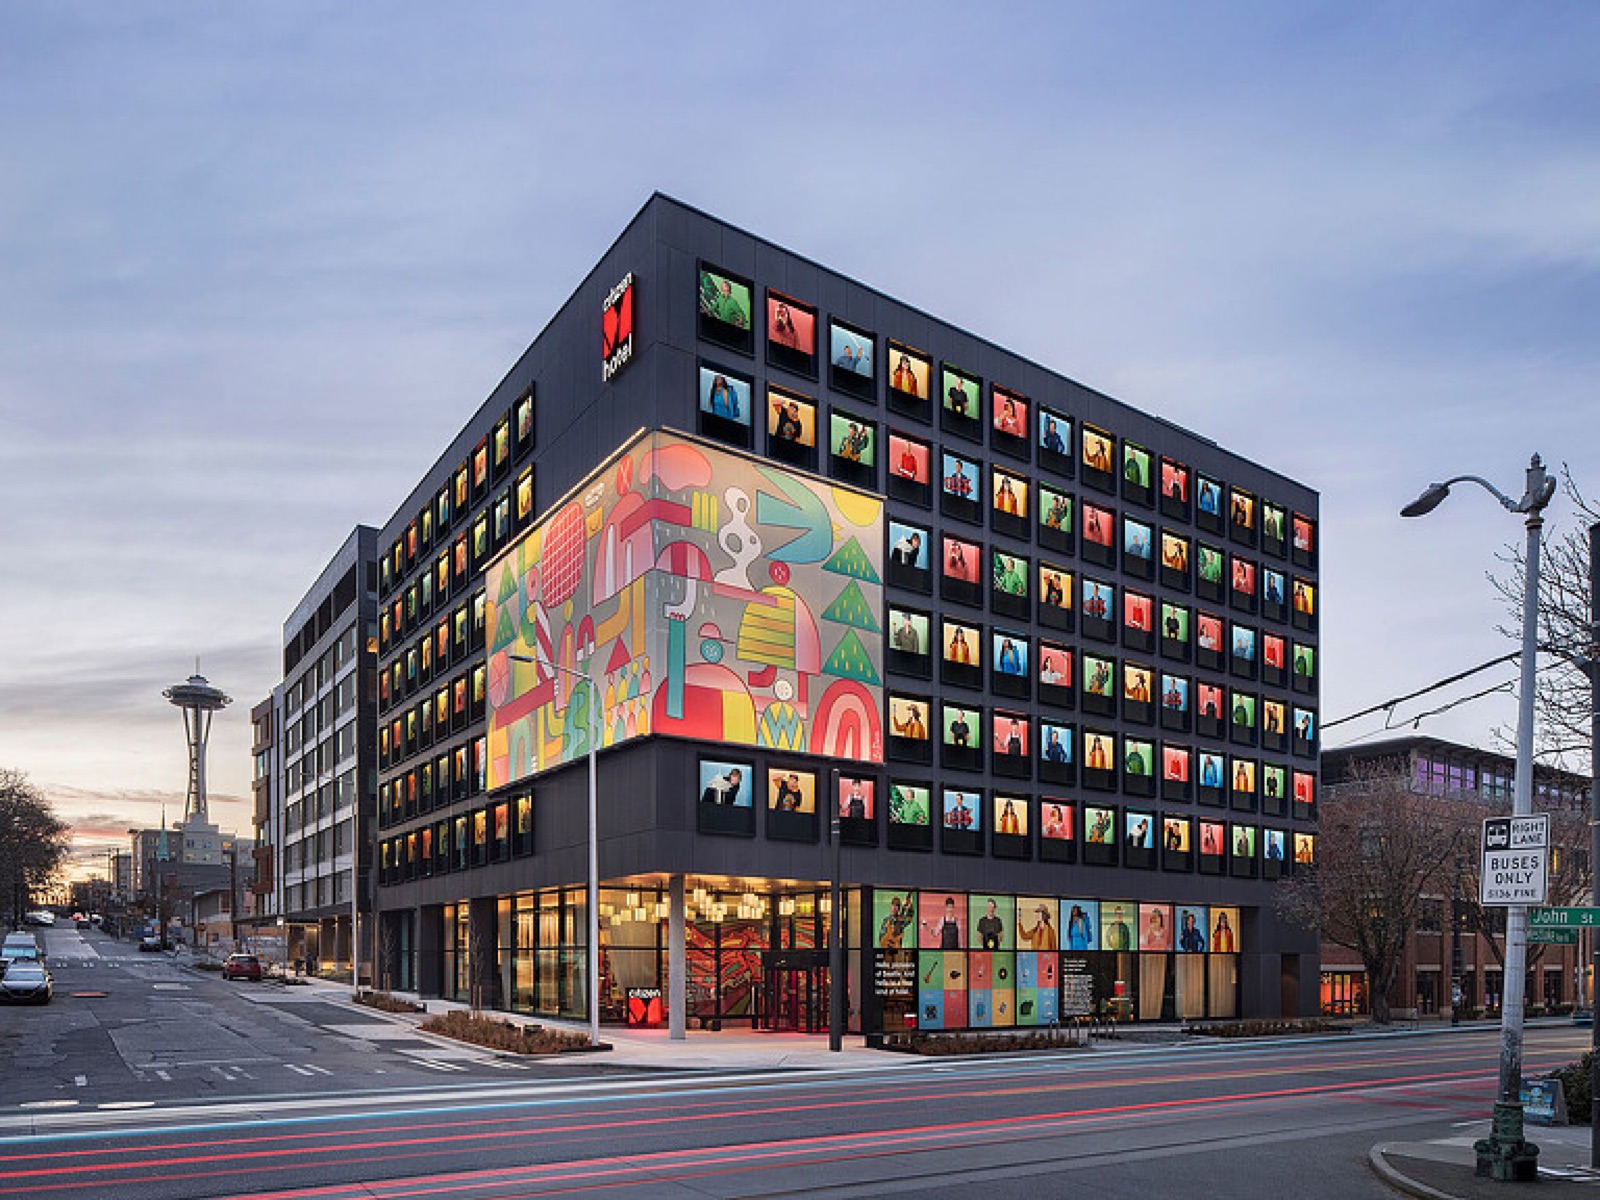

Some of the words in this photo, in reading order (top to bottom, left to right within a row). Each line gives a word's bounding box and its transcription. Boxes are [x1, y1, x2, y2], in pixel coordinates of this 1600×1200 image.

[602, 332, 632, 381] hotel
[1512, 822, 1545, 833] RIGHT
[1512, 833, 1543, 845] LANE
[1491, 856, 1539, 871] BUSES
[1495, 872, 1533, 885] ONLY
[1514, 889, 1537, 898] FINE
[1533, 907, 1568, 924] John
[1581, 912, 1593, 924] St
[628, 988, 661, 998] citizen
